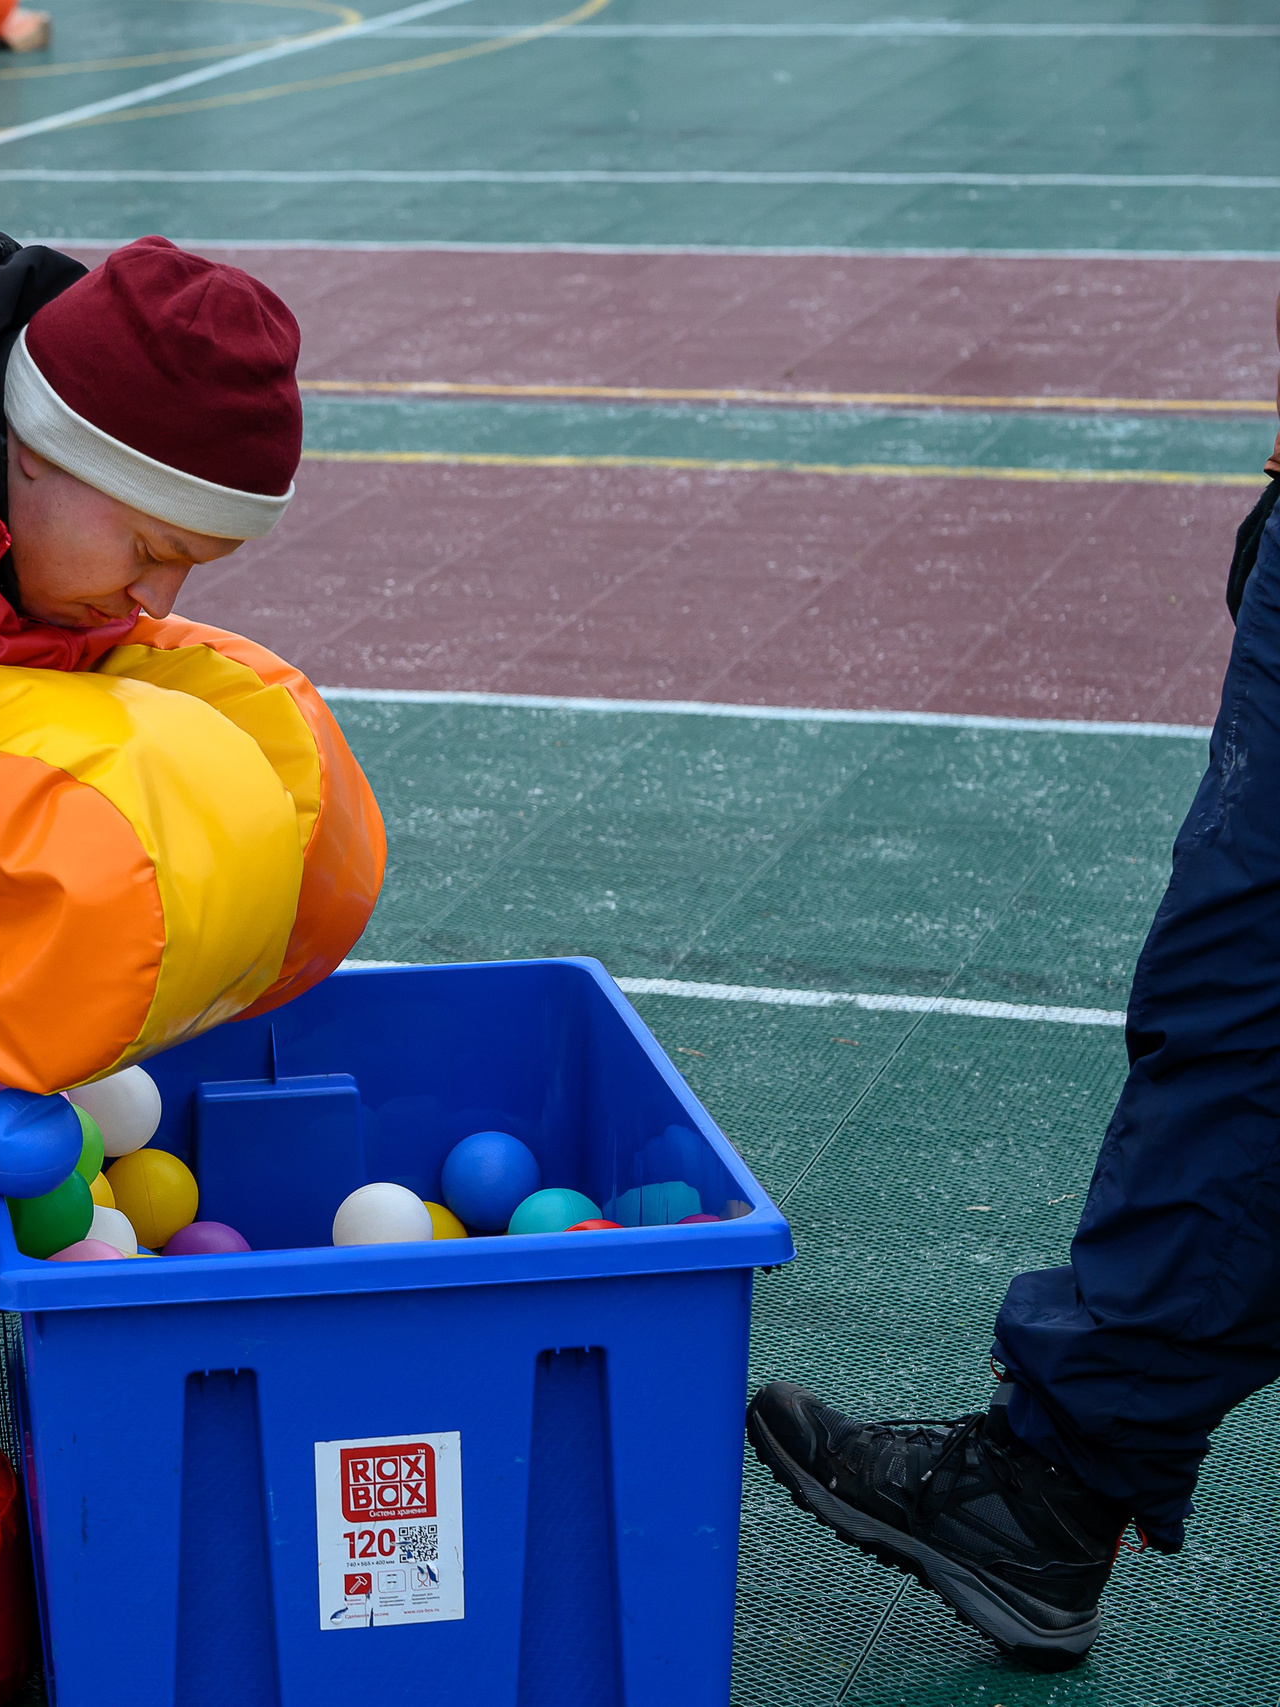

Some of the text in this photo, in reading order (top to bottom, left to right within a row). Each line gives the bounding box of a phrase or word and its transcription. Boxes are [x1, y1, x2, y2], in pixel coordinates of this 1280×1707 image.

[349, 1456, 426, 1483] ROX
[350, 1482, 426, 1510] BOX
[369, 1507, 428, 1518] Система хранения
[343, 1528, 396, 1559] 120
